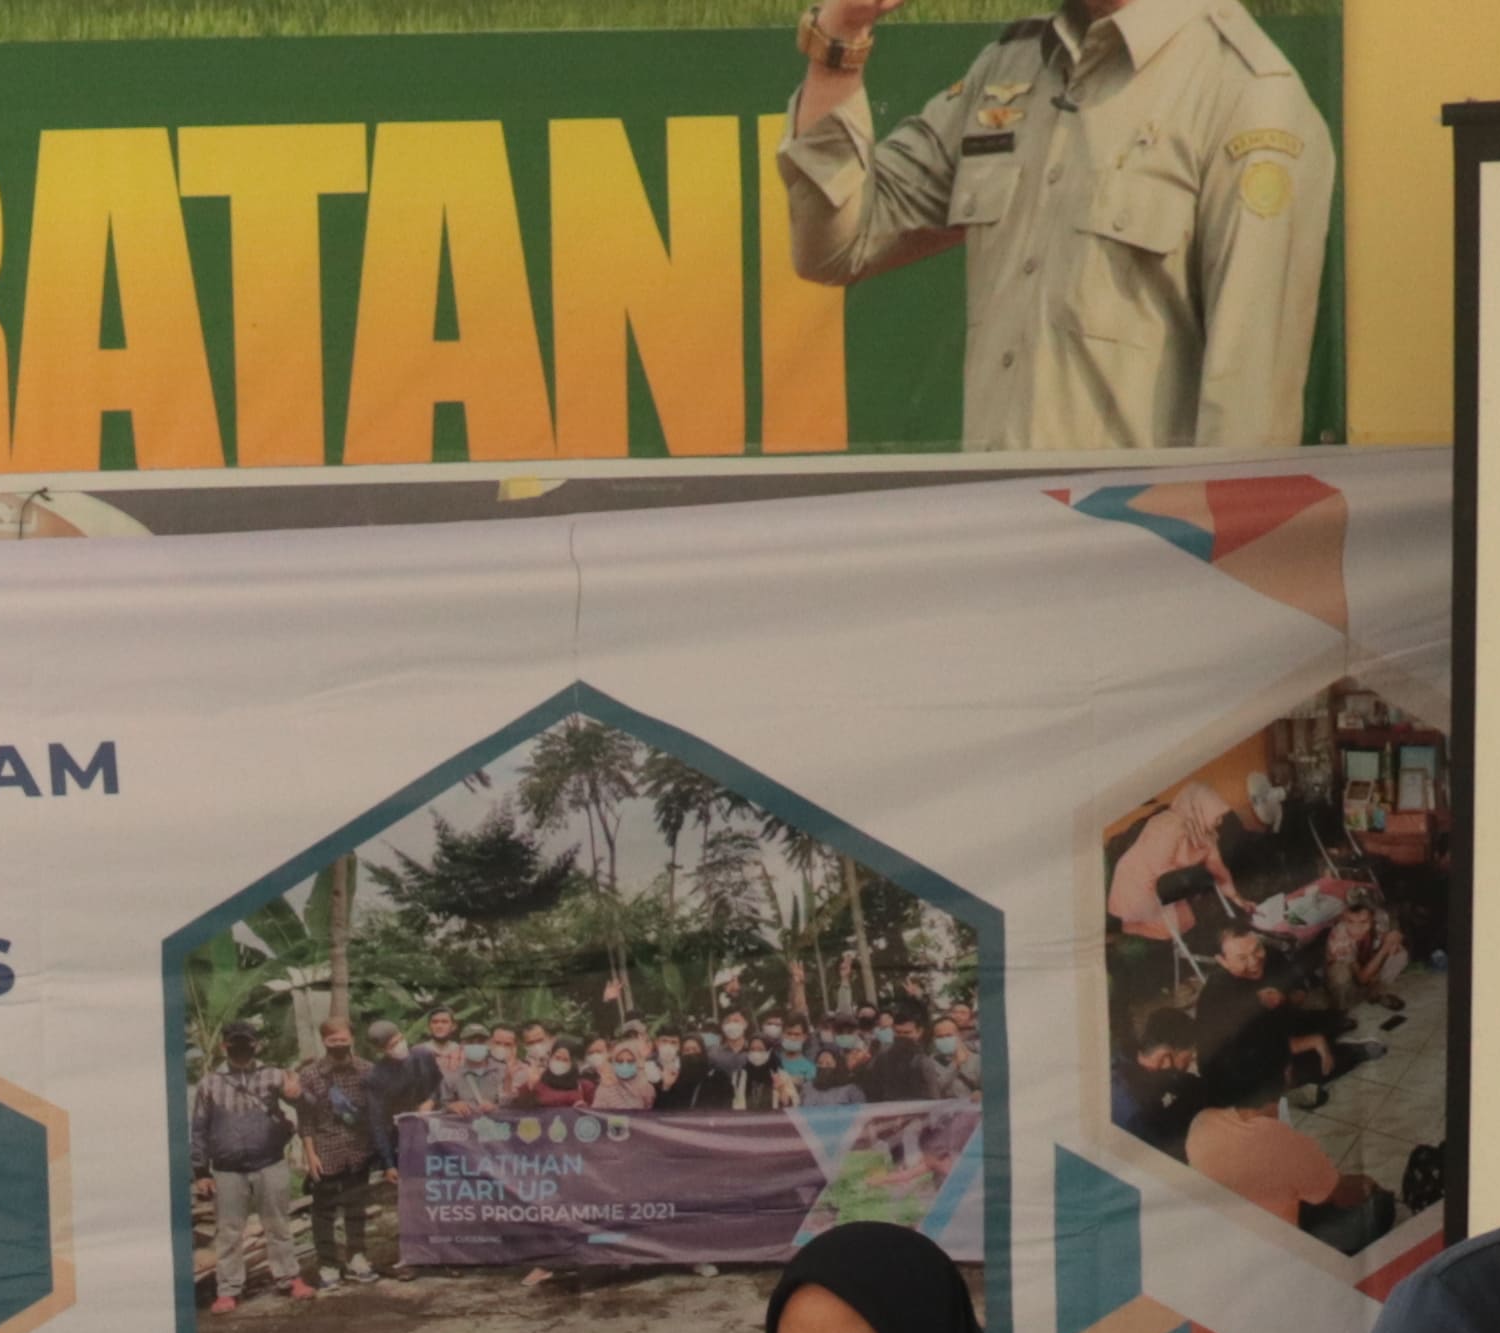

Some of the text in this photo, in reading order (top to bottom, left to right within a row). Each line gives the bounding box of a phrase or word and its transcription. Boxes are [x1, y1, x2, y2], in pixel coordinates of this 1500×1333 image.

[425, 1153, 584, 1177] PELATIHAN
[425, 1179, 558, 1201] START UP
[425, 1203, 675, 1222] YESS PROGRAMME 2021
